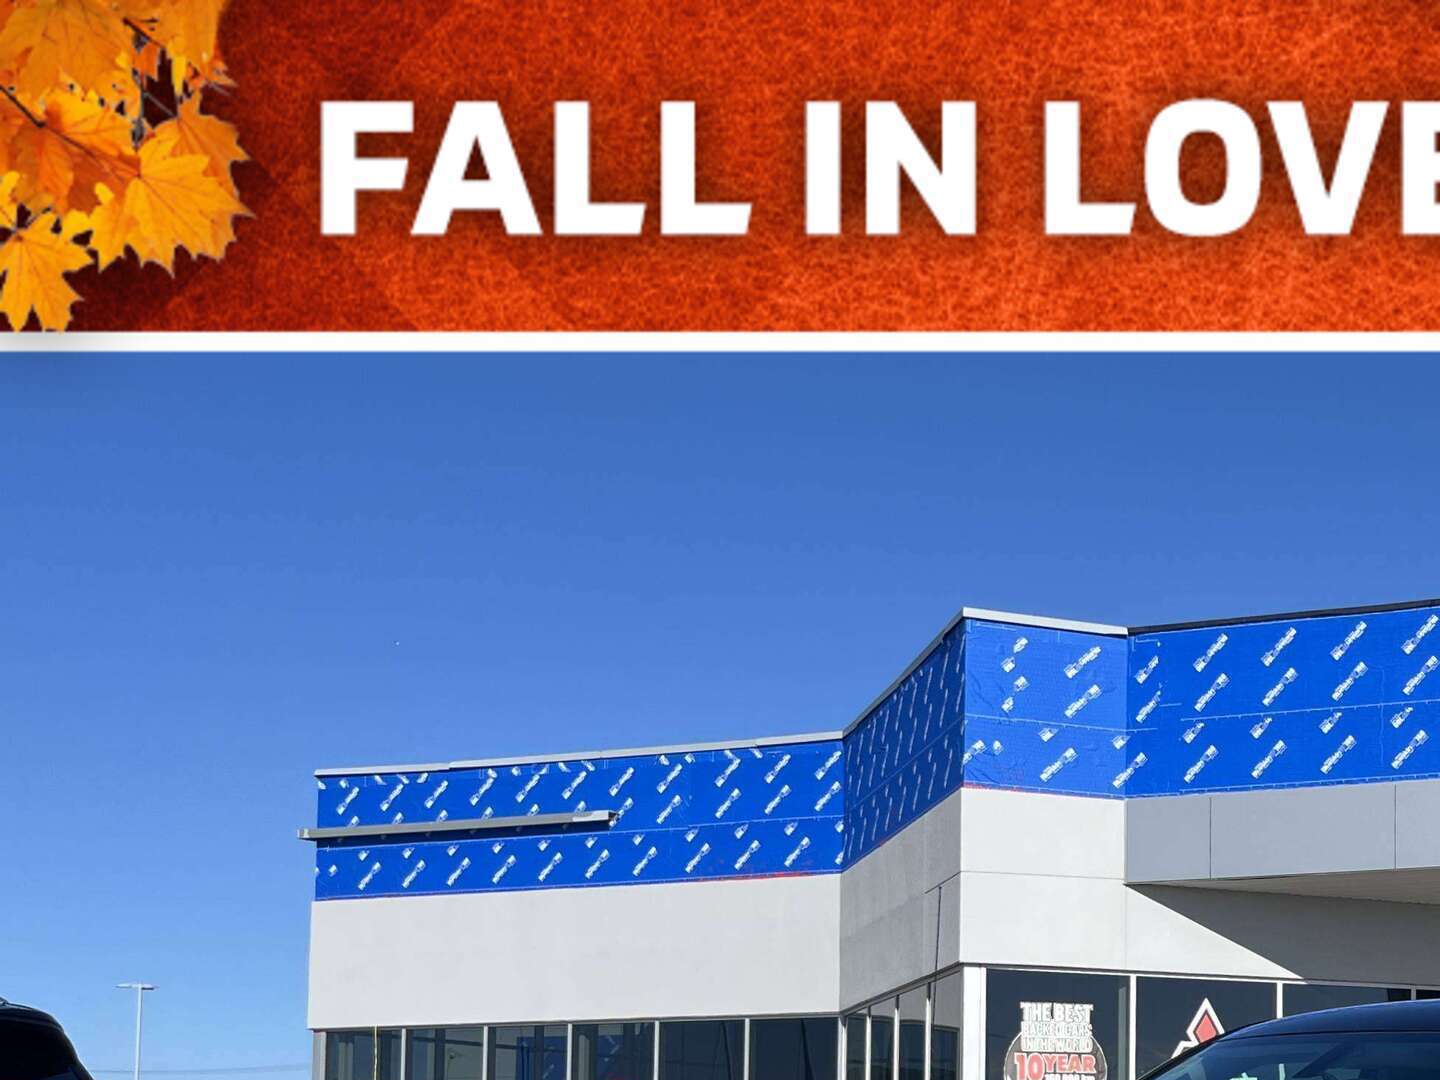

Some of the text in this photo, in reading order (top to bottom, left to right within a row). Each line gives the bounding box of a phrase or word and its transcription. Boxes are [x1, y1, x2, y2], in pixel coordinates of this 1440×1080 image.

[1020, 1002, 1093, 1022] THE BEST
[1043, 1054, 1096, 1073] YEAR
